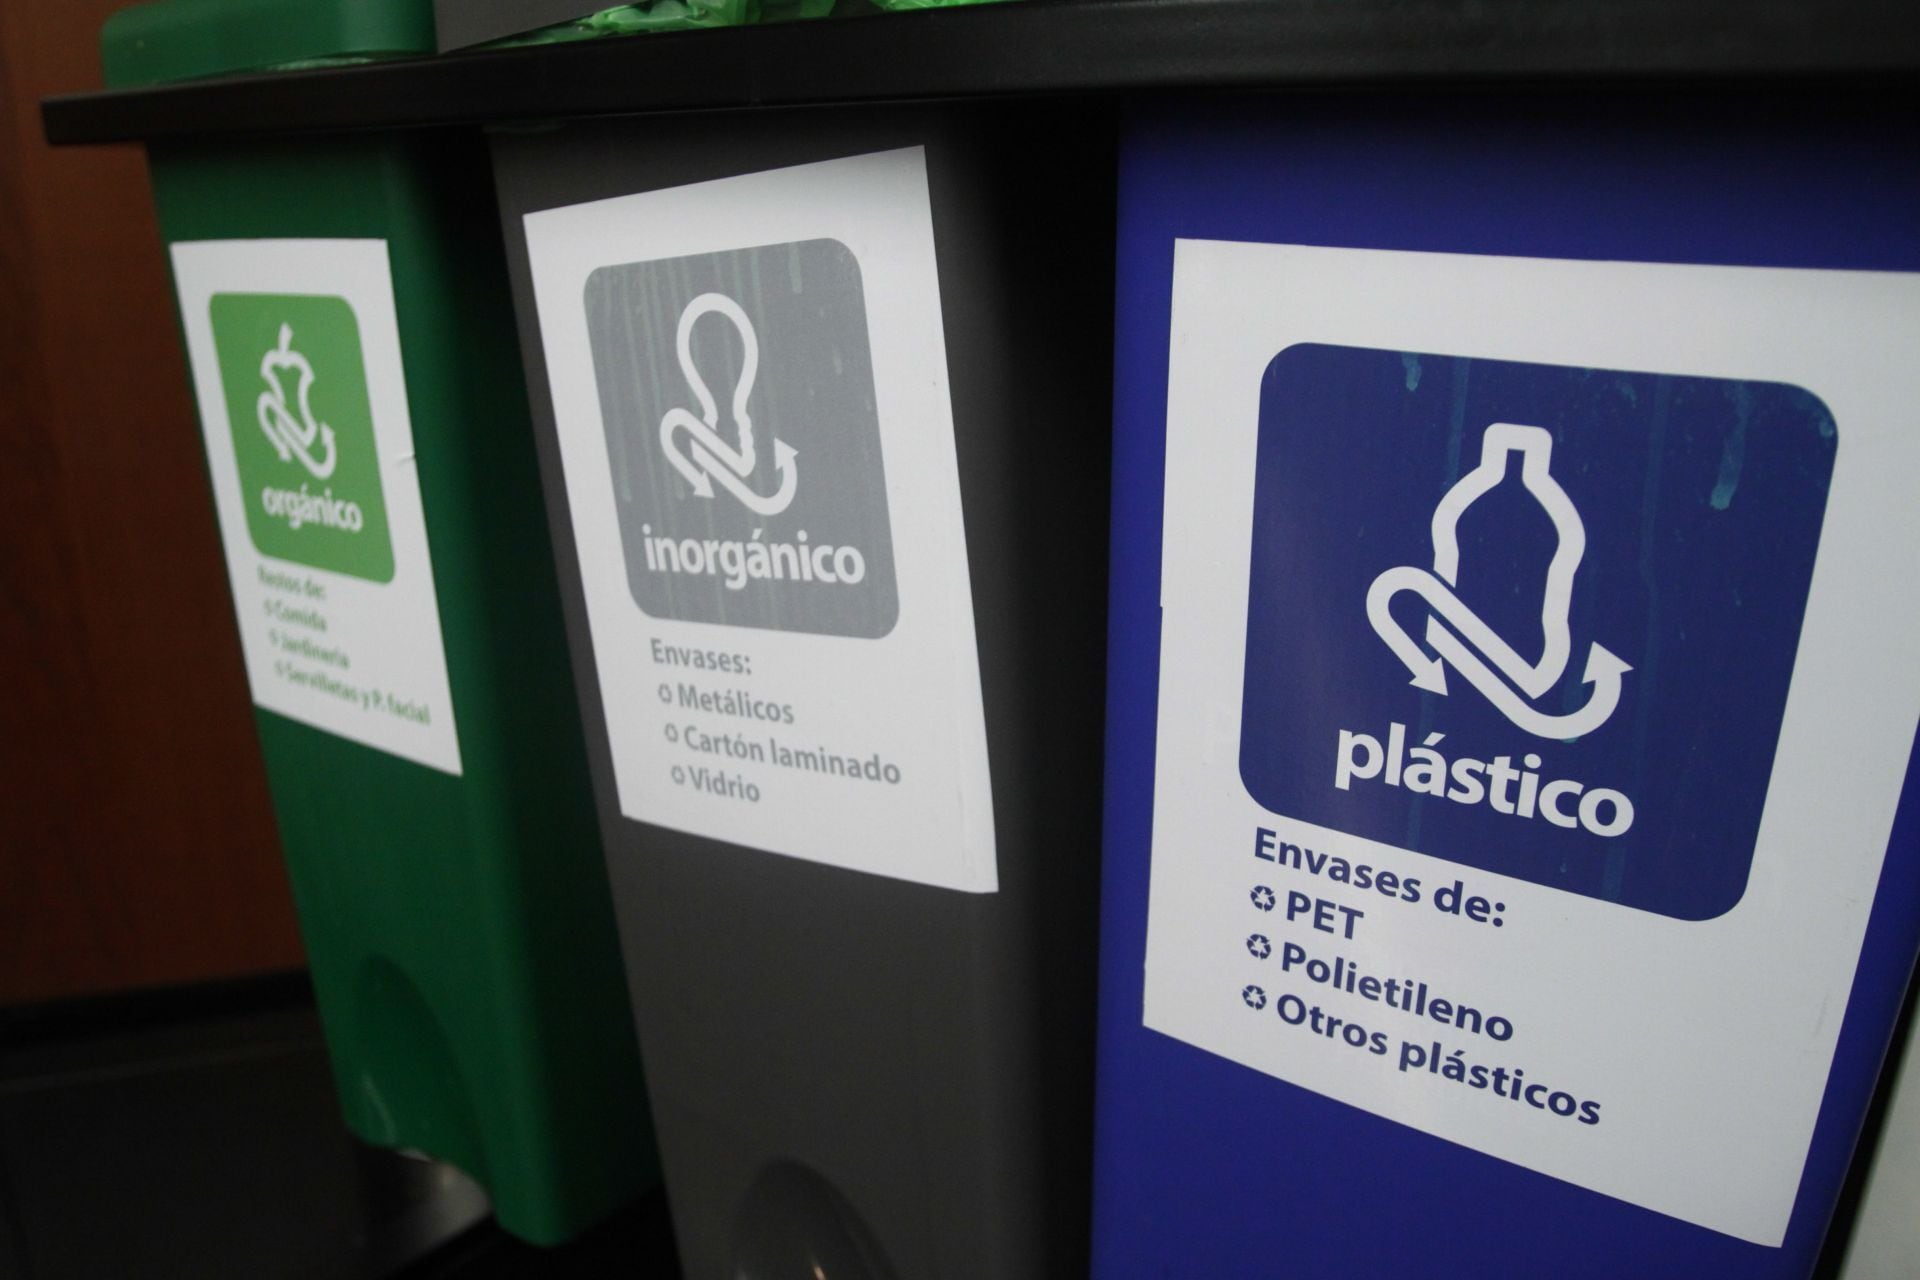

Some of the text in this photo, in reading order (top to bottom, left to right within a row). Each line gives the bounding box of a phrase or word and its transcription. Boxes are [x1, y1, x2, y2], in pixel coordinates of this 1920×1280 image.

[262, 483, 363, 533] orgánico
[642, 524, 866, 590] inorgánico
[275, 600, 327, 632] Comida
[651, 638, 752, 675] Envases:
[286, 661, 358, 703] Servilletas
[387, 691, 432, 725] facial
[677, 682, 795, 725] Metálicos
[684, 725, 901, 785] Cartón laminado
[689, 765, 760, 802] Vidrio
[1335, 722, 1634, 837] plástico
[1254, 826, 1506, 927] Envases de:
[1286, 890, 1364, 940] PET
[1282, 941, 1514, 1041] Polietileno
[1277, 993, 1601, 1126] Otros plásticos
